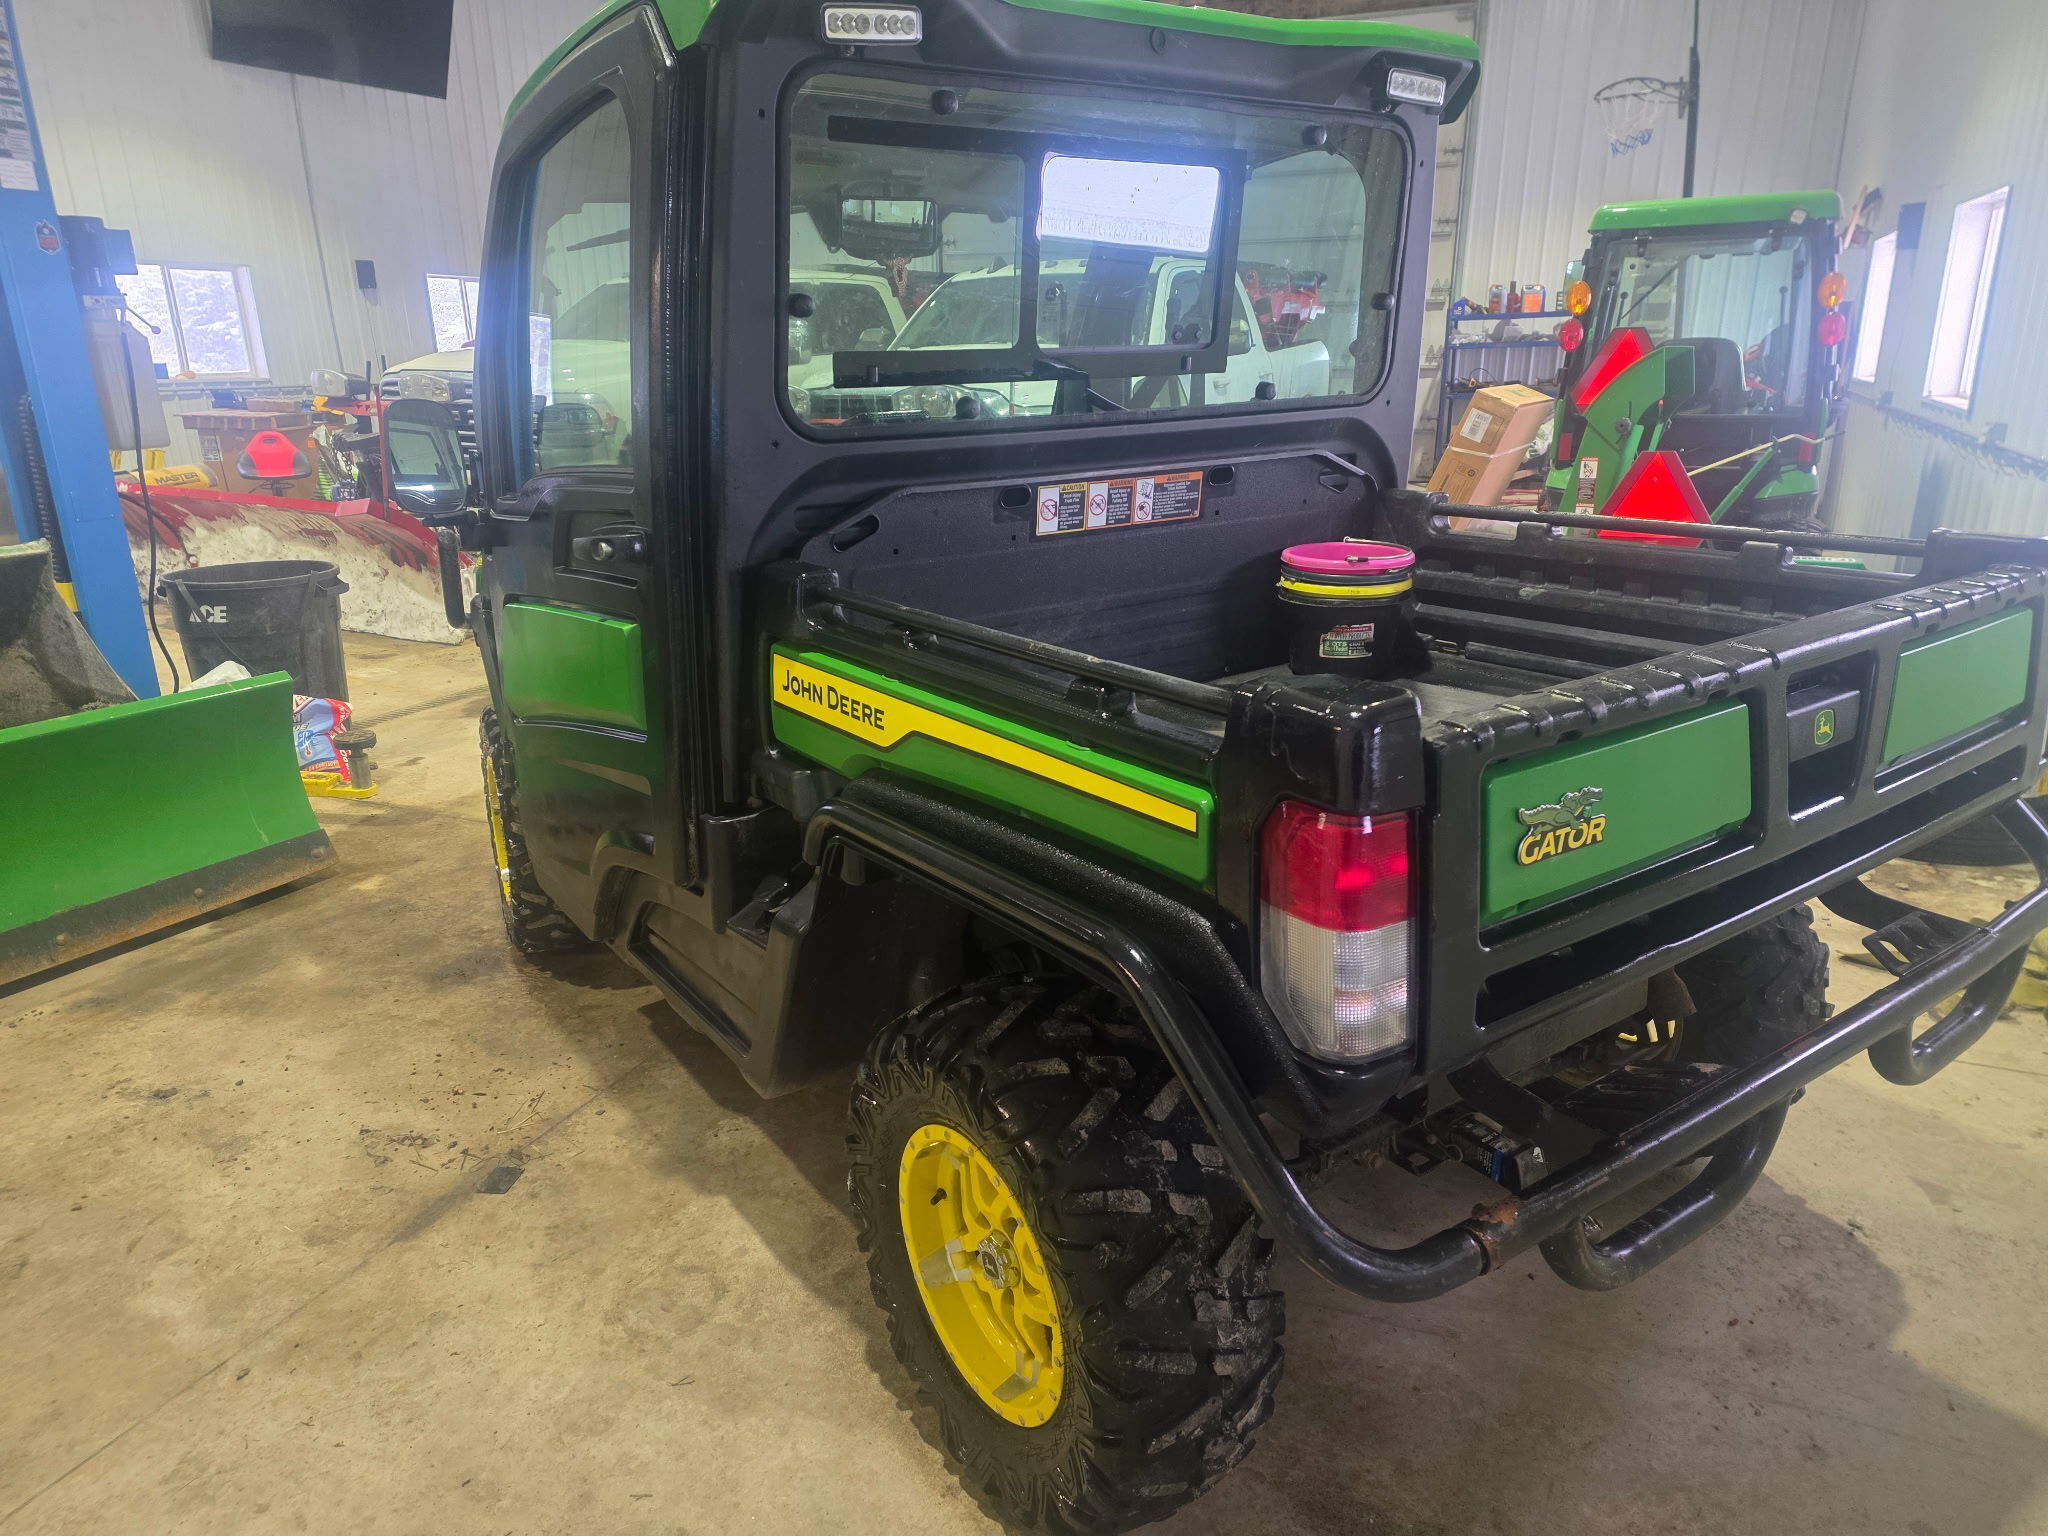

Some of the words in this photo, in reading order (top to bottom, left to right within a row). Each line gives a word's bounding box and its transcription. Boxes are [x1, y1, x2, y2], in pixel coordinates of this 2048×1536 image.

[154, 472, 199, 484] MASTER
[1066, 483, 1085, 492] CAUTION
[189, 604, 227, 623] ACE
[782, 669, 823, 706] JOHN
[827, 684, 885, 731] DEERE
[1520, 816, 1606, 865] GATOR
